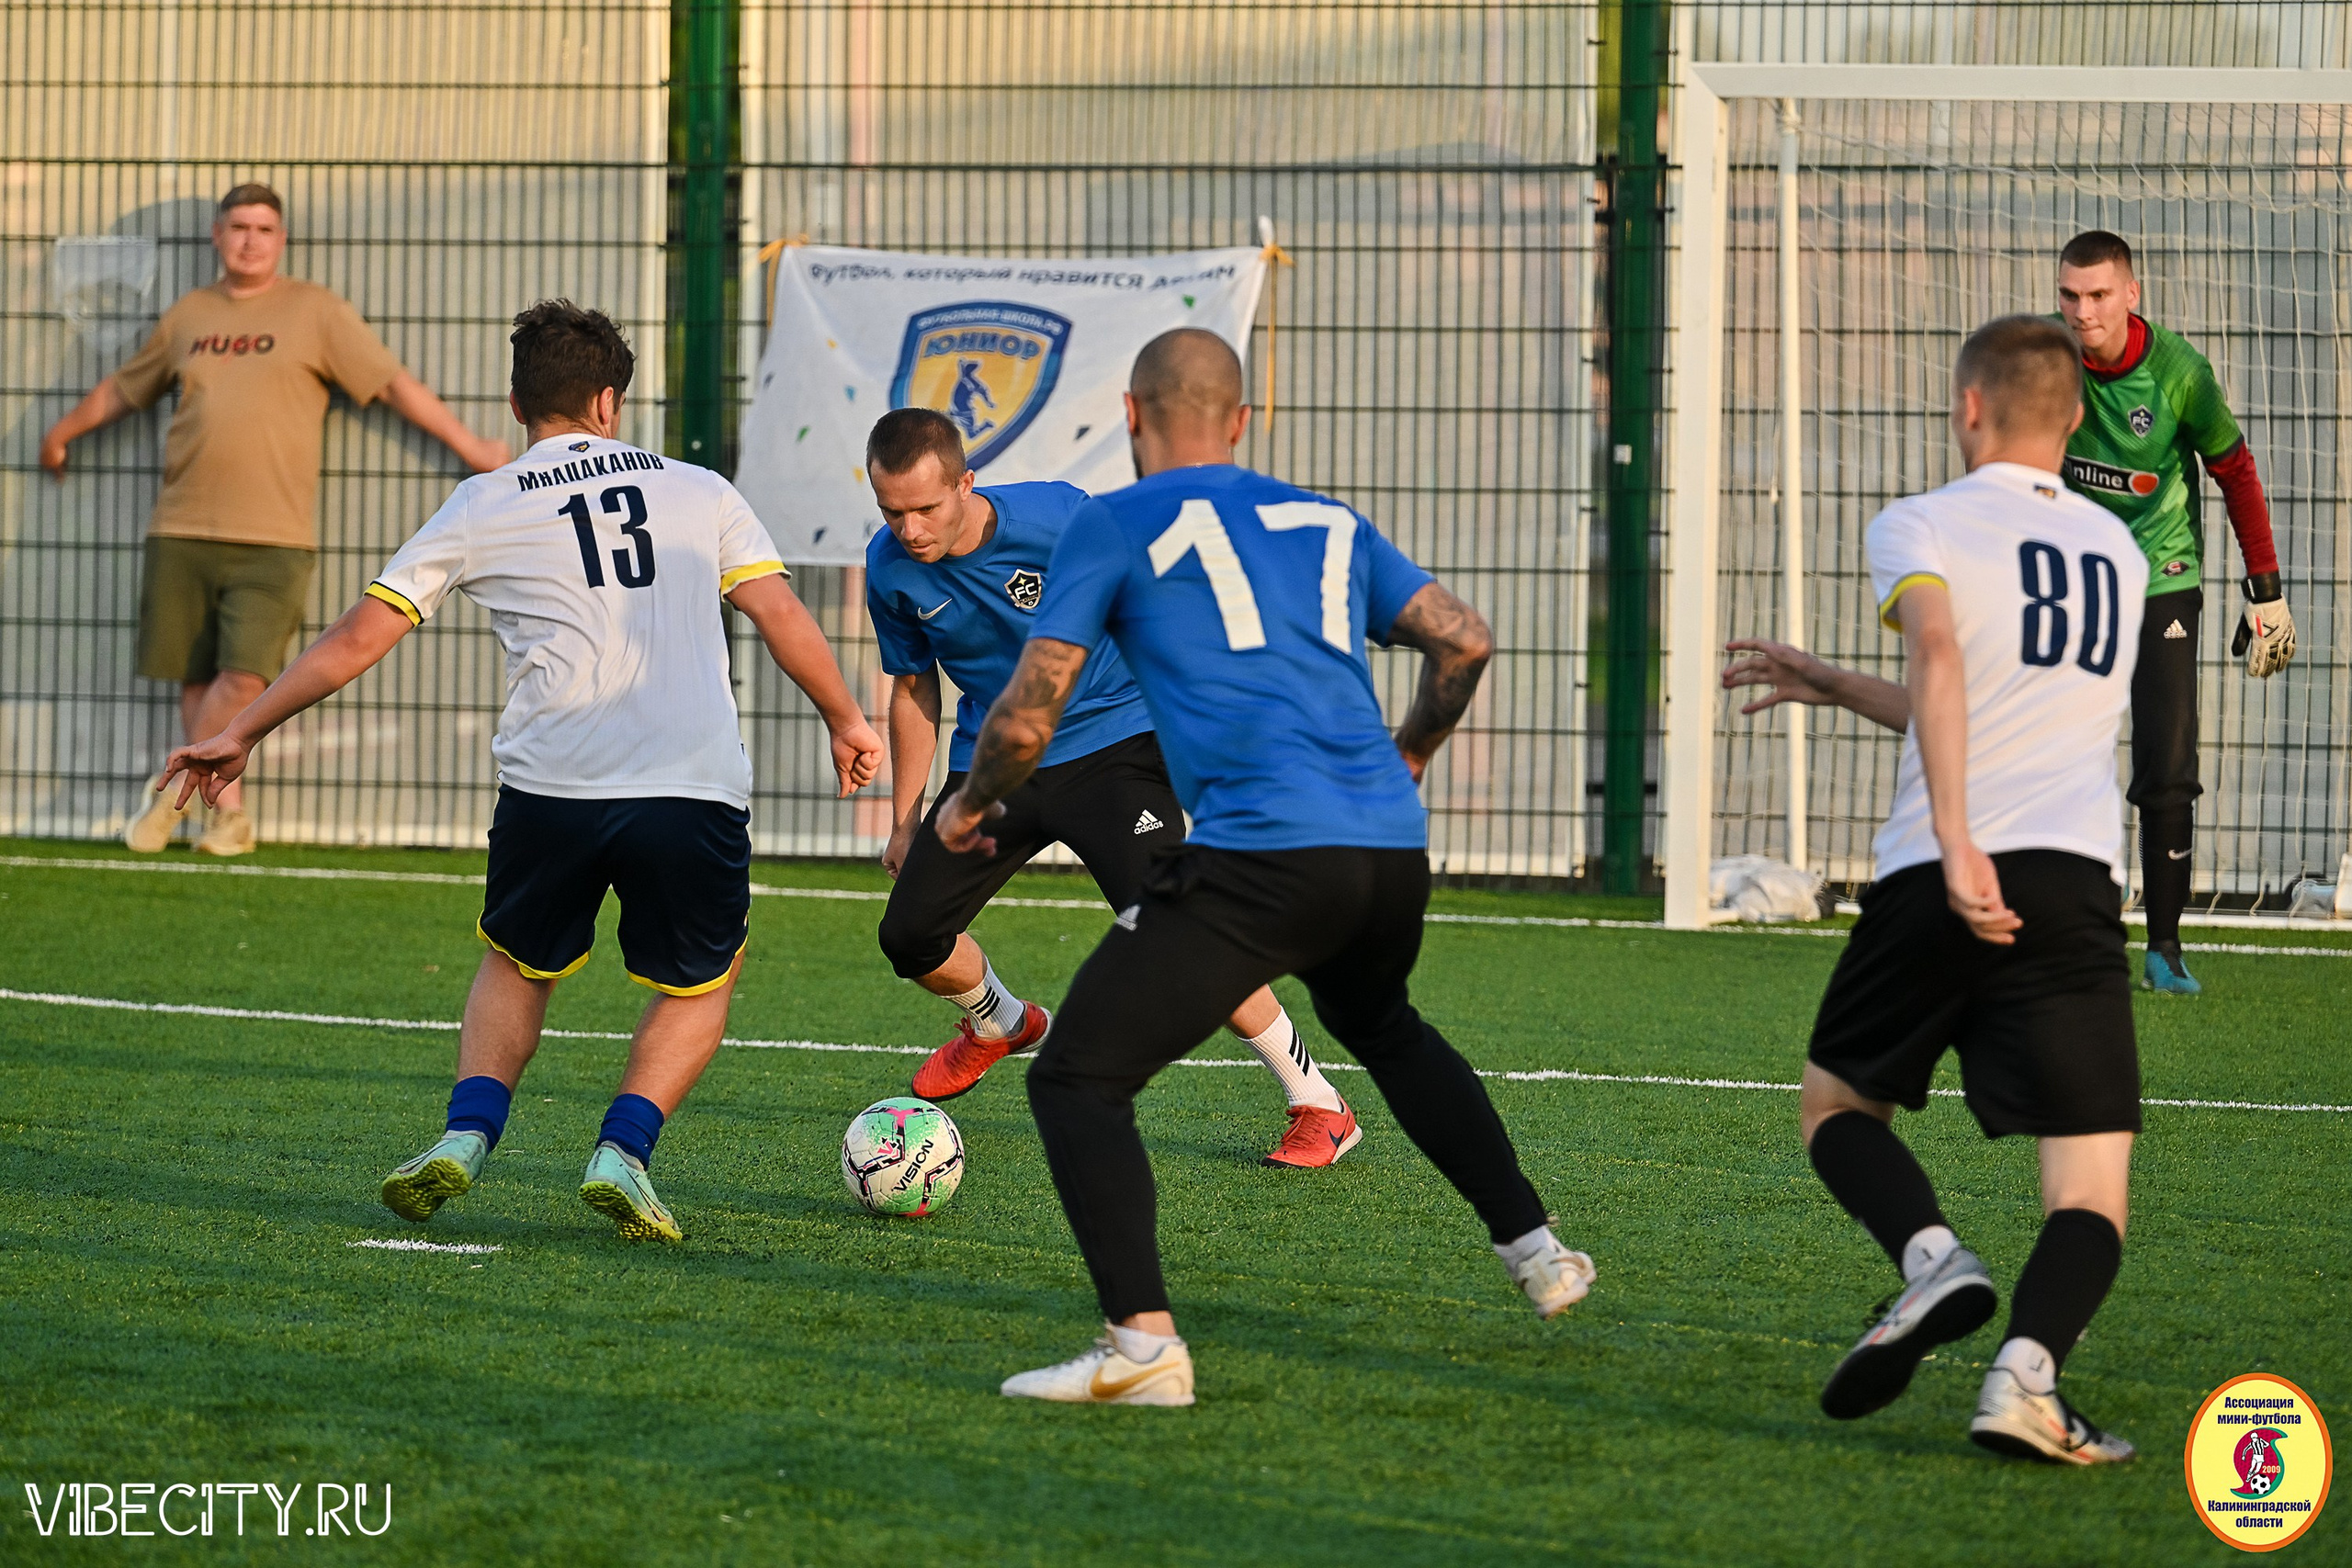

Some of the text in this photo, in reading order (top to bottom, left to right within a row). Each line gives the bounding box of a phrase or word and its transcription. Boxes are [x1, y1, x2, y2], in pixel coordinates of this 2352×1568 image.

[188, 333, 275, 356] HUGO
[922, 331, 1041, 359] ЮНИОР
[2069, 463, 2124, 489] nline
[558, 485, 655, 589] 13
[1014, 582, 1038, 600] FC
[1148, 499, 1358, 655] 17
[2018, 538, 2119, 677] 80
[1134, 819, 1164, 835] adidas
[892, 1138, 934, 1192] VISION
